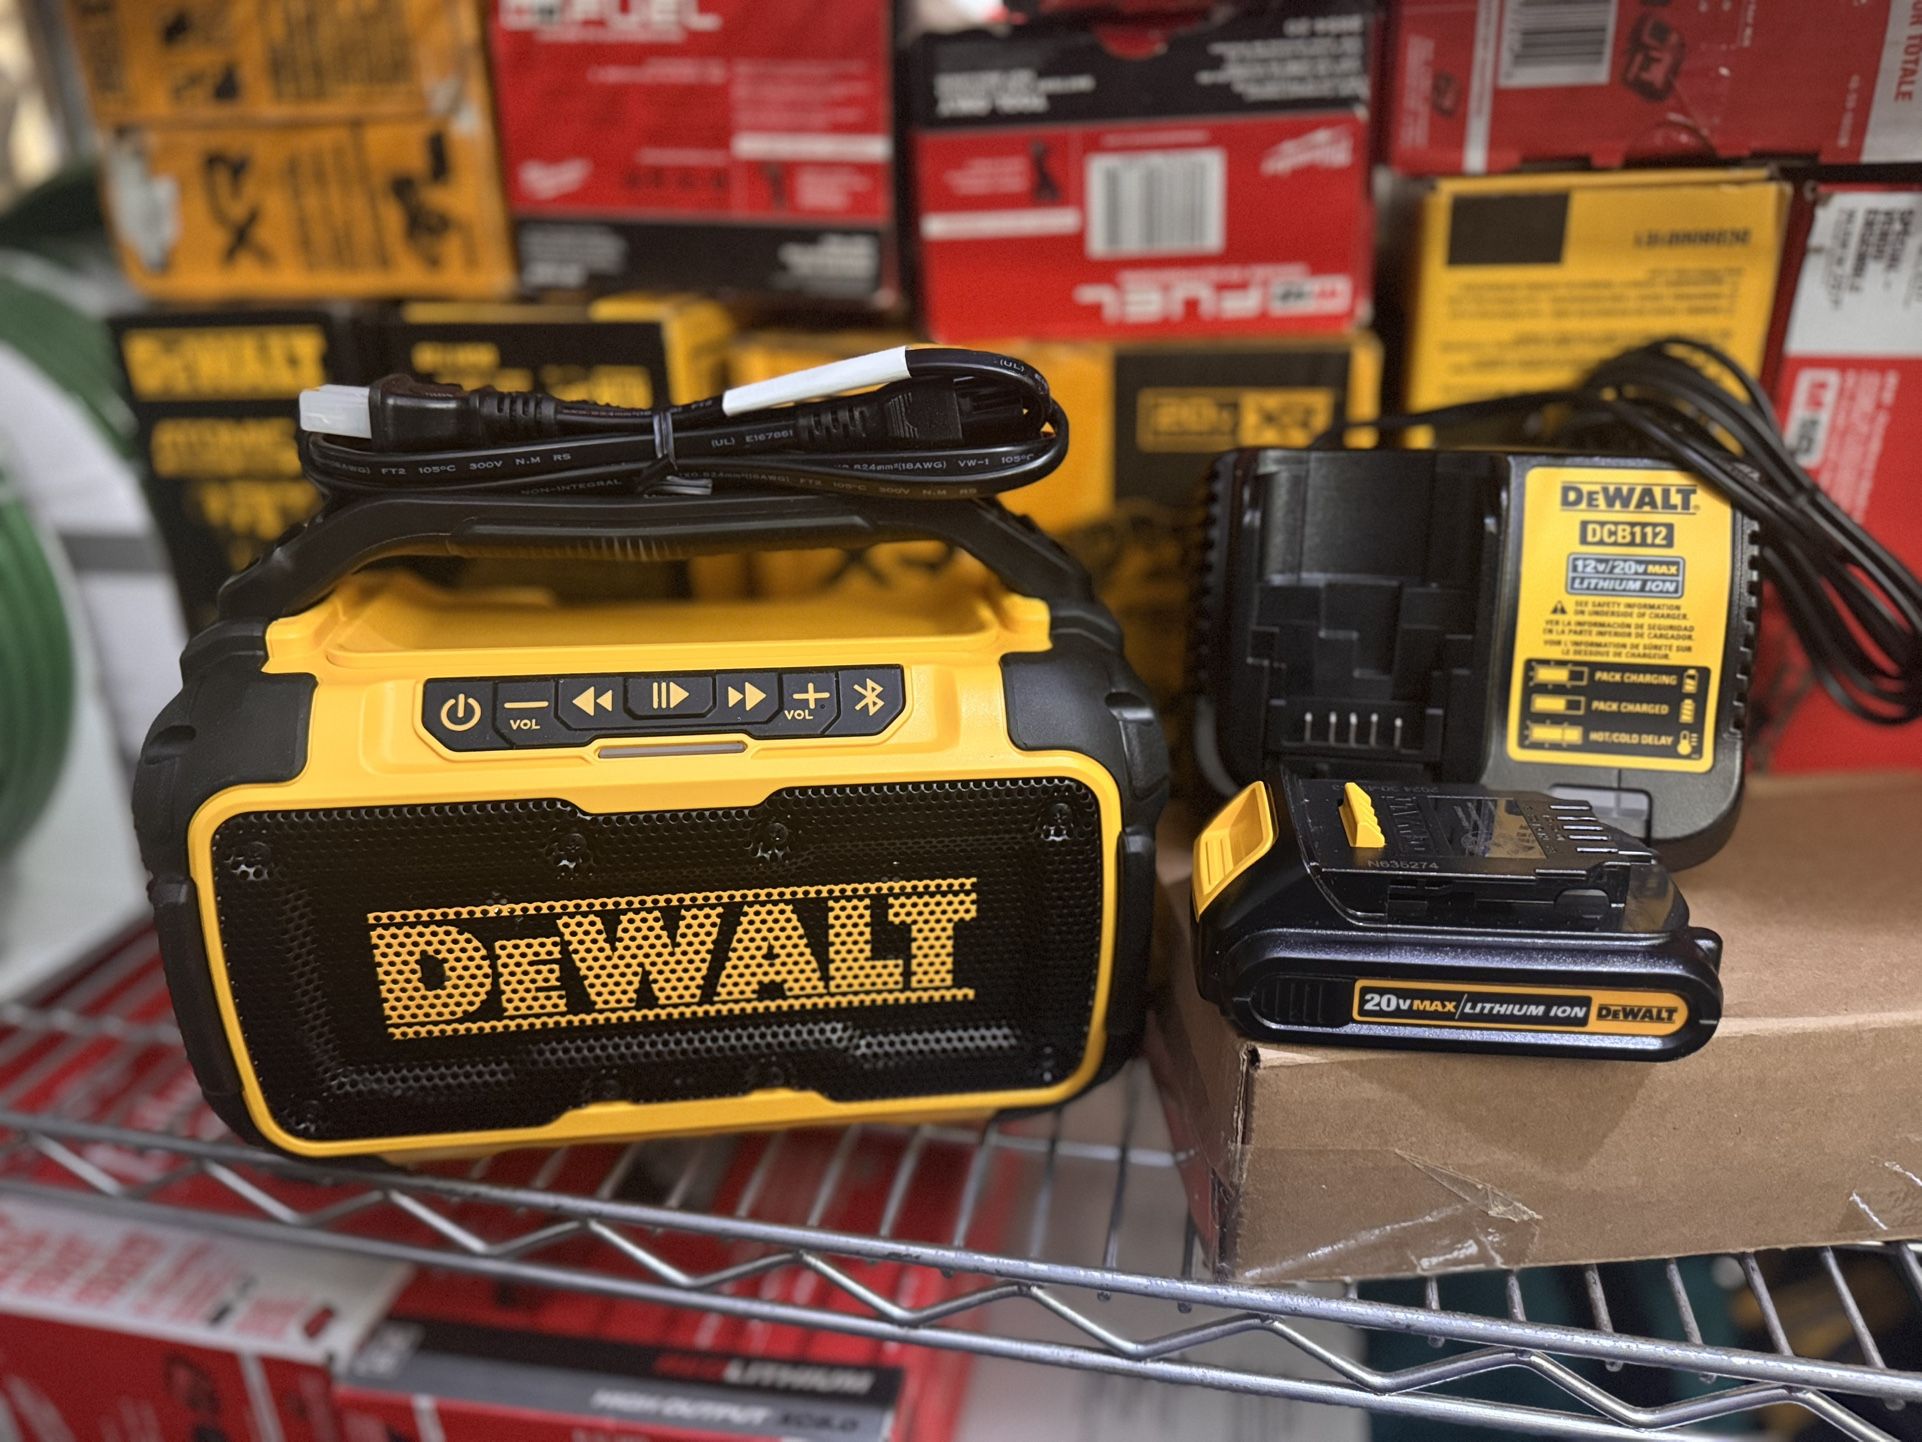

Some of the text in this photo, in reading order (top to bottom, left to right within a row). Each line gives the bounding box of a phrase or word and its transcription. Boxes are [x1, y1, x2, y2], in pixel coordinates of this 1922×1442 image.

[711, 437, 736, 448] (UL)
[381, 467, 407, 475] FT2
[469, 460, 503, 471] 300V
[515, 456, 542, 465] N.M
[552, 453, 572, 461] RS
[958, 458, 990, 468] VW-1
[520, 479, 624, 496] NON-INTEGRAL
[1560, 484, 1698, 512] DEWALT
[1585, 522, 1668, 546] DCB112
[1572, 578, 1678, 593] LITHIUM ION
[1591, 600, 1621, 610] SAFETY
[1623, 602, 1682, 612] INFORMATION
[1588, 609, 1633, 619] UNDERSIDE
[1647, 624, 1695, 633] SEGURIDAD
[1594, 670, 1678, 687] PACK CHARGING
[784, 709, 814, 721] VOL
[1591, 700, 1670, 716] PACK CHARGED
[510, 718, 541, 730] VOL
[1588, 731, 1674, 747] HOT/COLD DELAY
[368, 892, 977, 1024] DEWALT
[1549, 1006, 1587, 1018] ION
